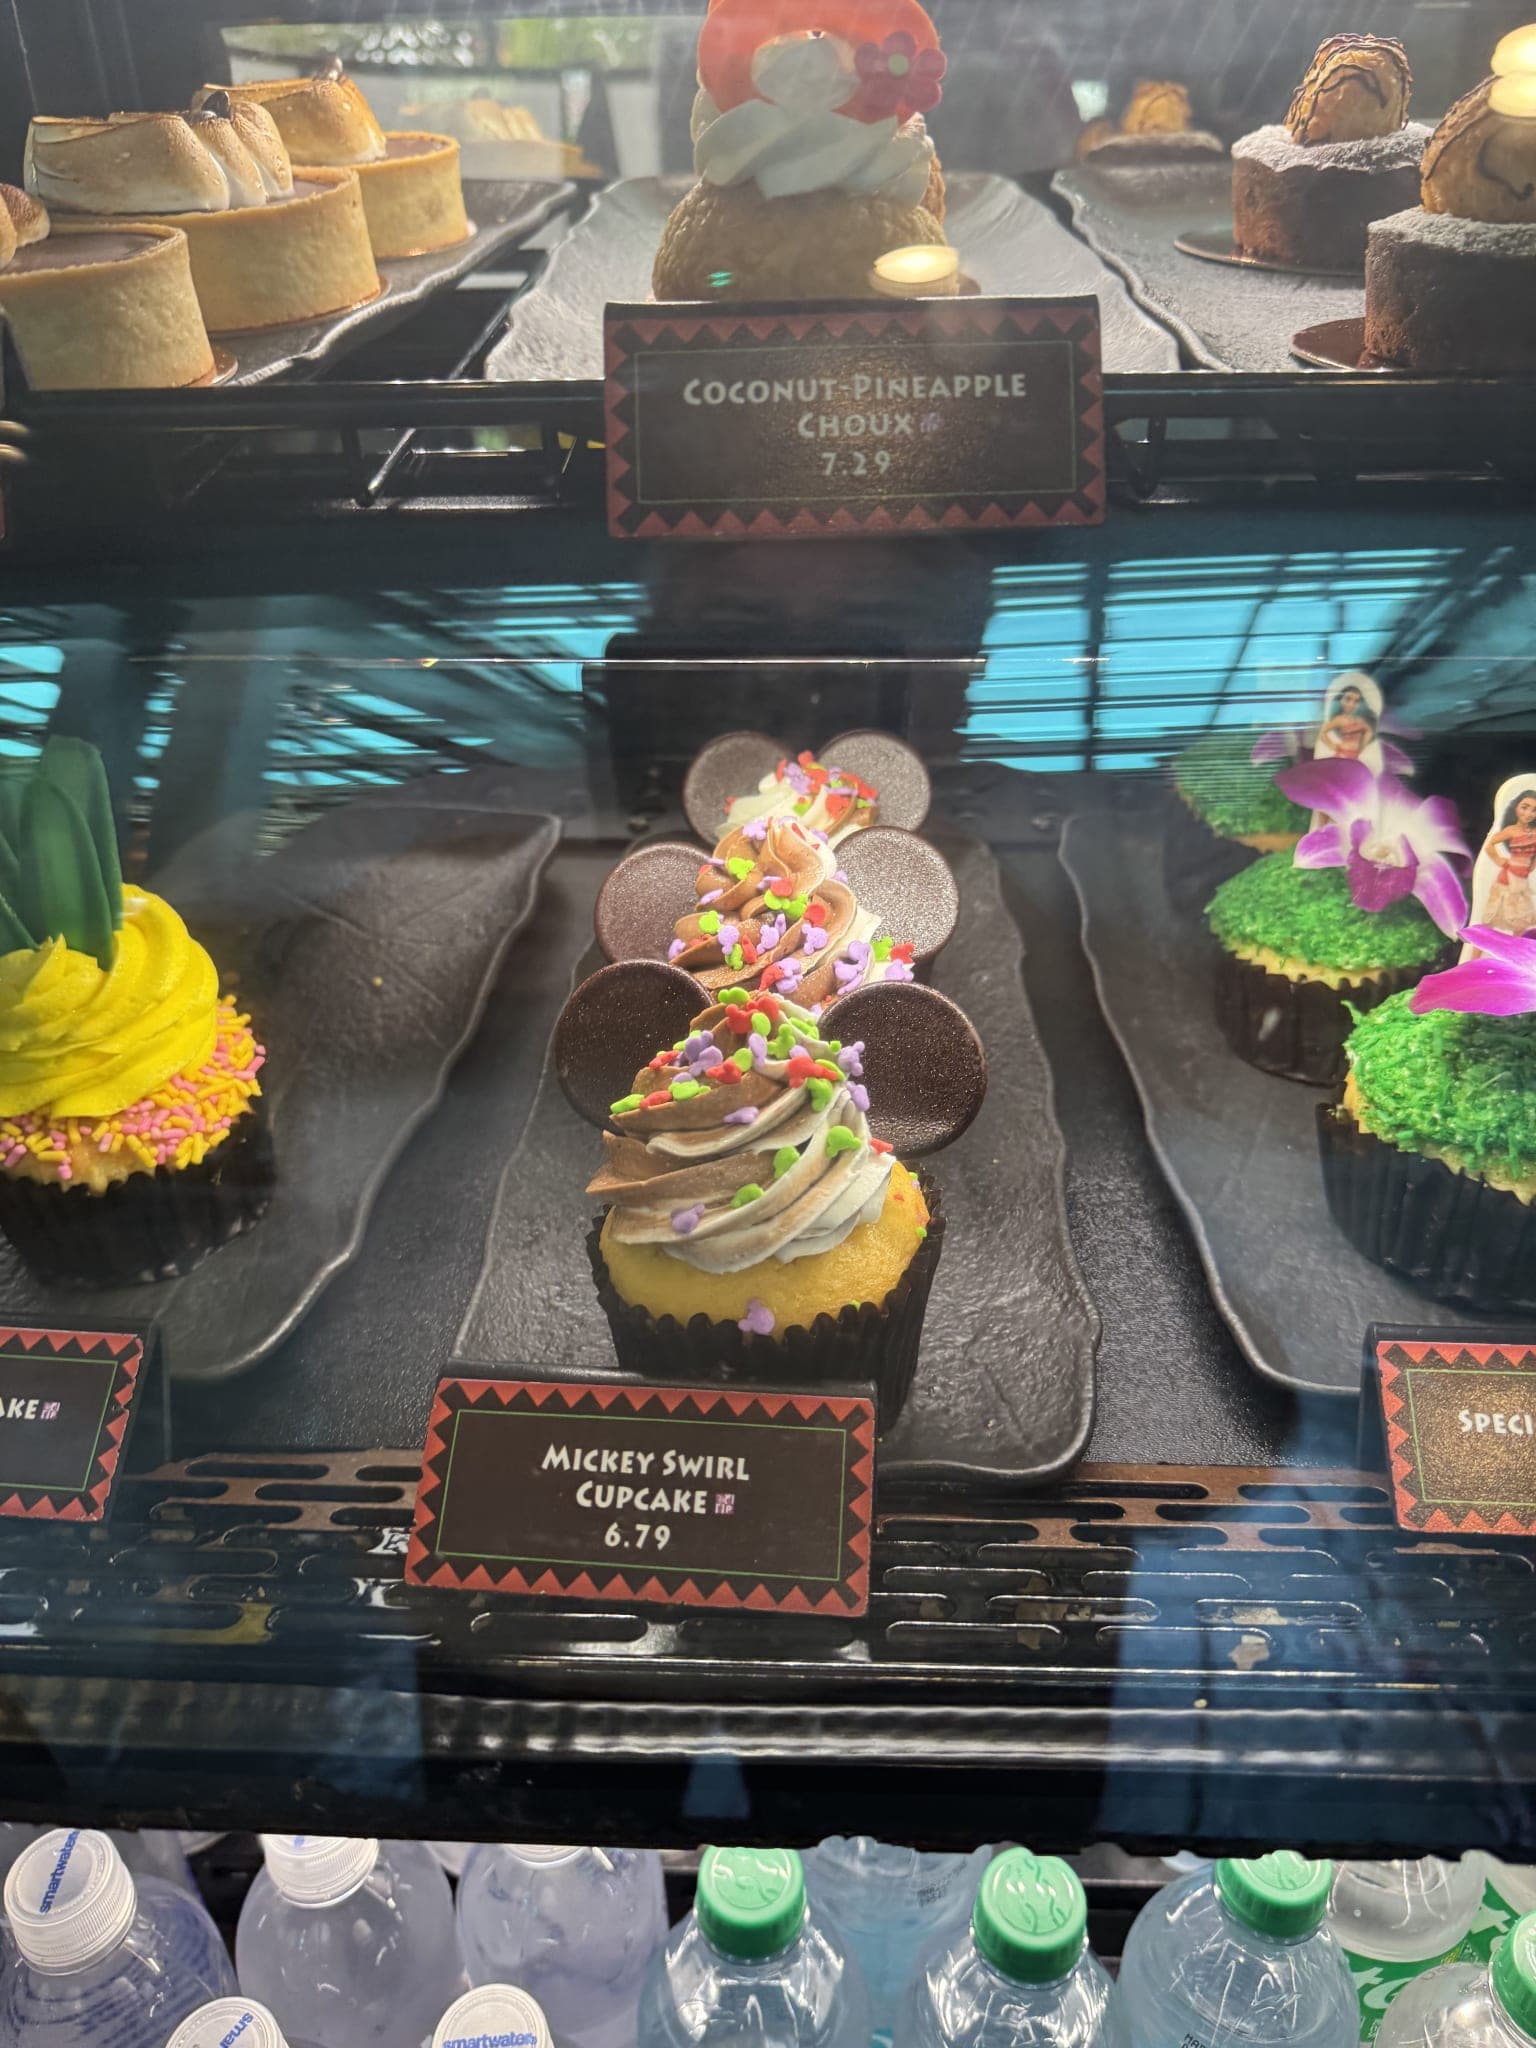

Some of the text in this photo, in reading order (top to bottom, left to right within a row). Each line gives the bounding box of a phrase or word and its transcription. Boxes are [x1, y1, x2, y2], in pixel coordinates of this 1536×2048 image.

[683, 373, 1027, 405] COCONUT-PINEAPPLE
[798, 412, 912, 438] CHOUX
[821, 451, 892, 476] 7.29
[541, 1443, 749, 1482] MICKEY SWIRL
[576, 1480, 707, 1514] CUPCAKE
[604, 1521, 671, 1550] 6.79
